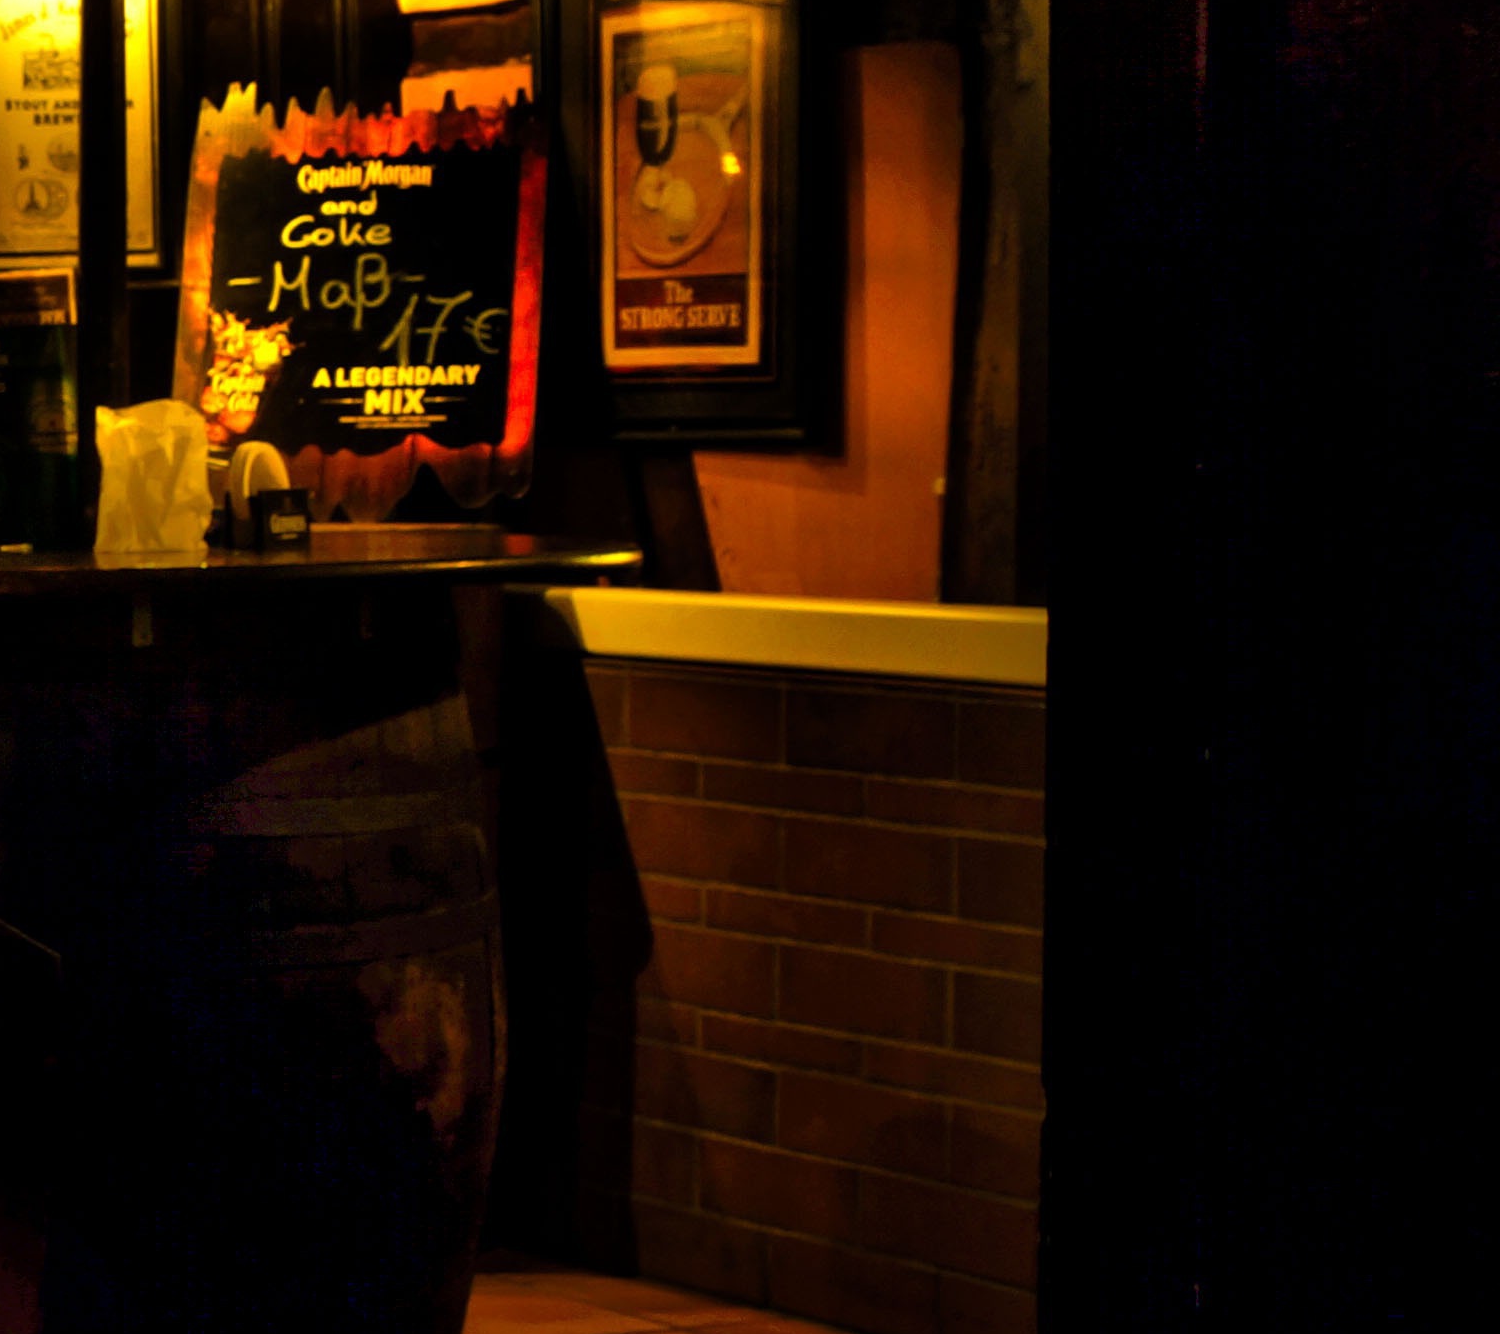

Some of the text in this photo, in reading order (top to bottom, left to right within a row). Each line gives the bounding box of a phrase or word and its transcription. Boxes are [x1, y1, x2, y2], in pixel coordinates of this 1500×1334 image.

[5, 98, 49, 111] STOUT
[296, 159, 434, 194] Captain Morgan
[320, 189, 378, 216] and
[280, 214, 393, 249] Coke
[663, 279, 695, 305] The
[311, 363, 482, 389] A LEGENDARY
[363, 387, 426, 415] MIX
